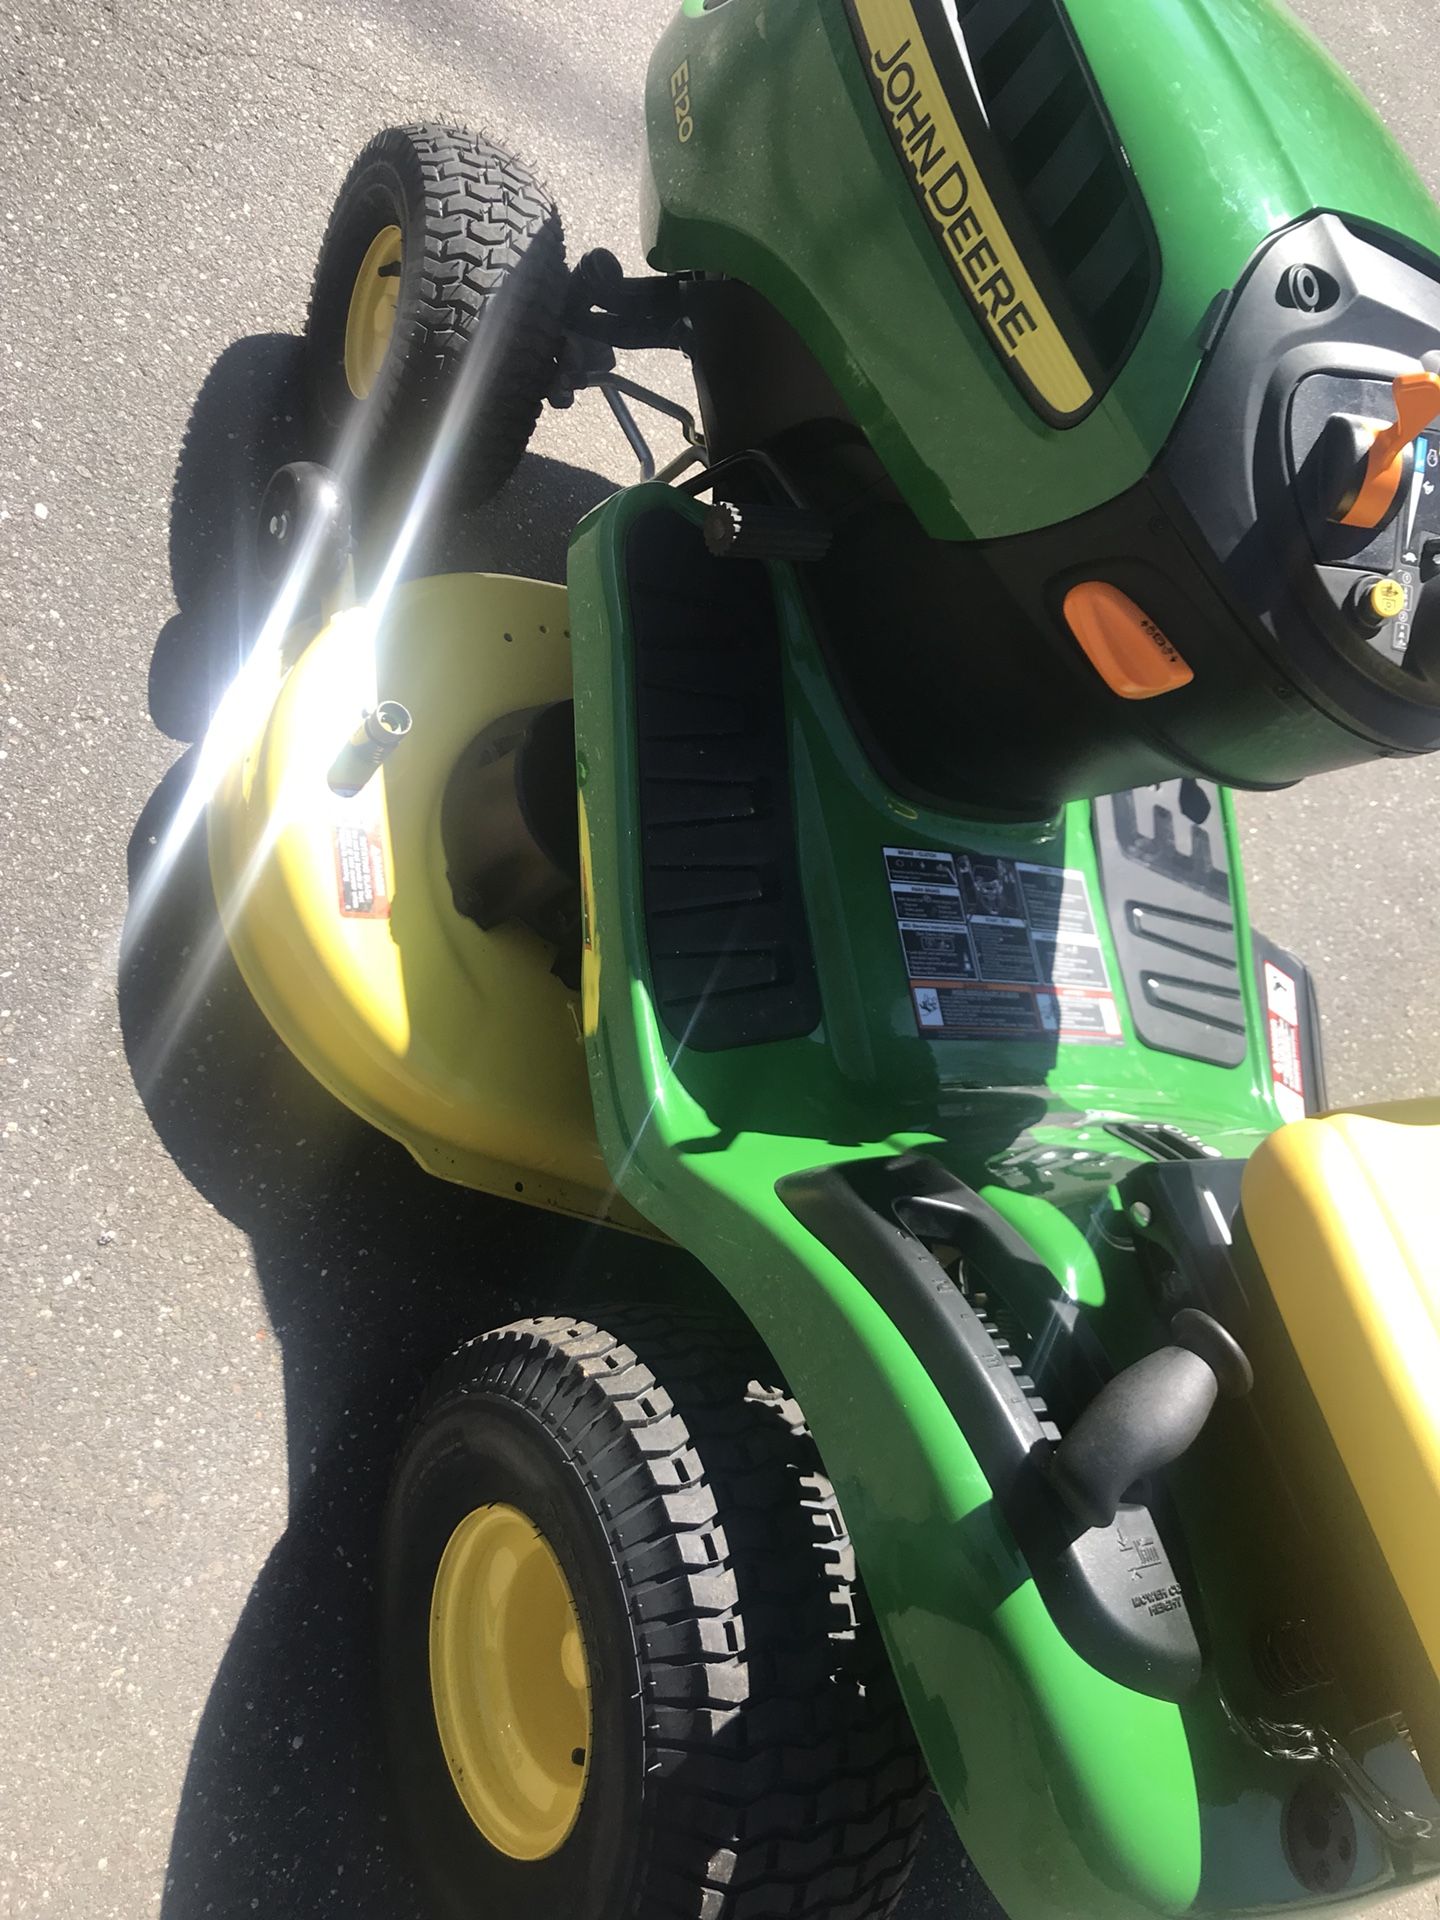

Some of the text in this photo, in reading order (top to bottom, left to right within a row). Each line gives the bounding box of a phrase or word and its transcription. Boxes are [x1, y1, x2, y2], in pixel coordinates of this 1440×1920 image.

[670, 59, 693, 143] E120
[874, 38, 1038, 350] JOHN DEERE
[1131, 1582, 1182, 1608] MOWER CU
